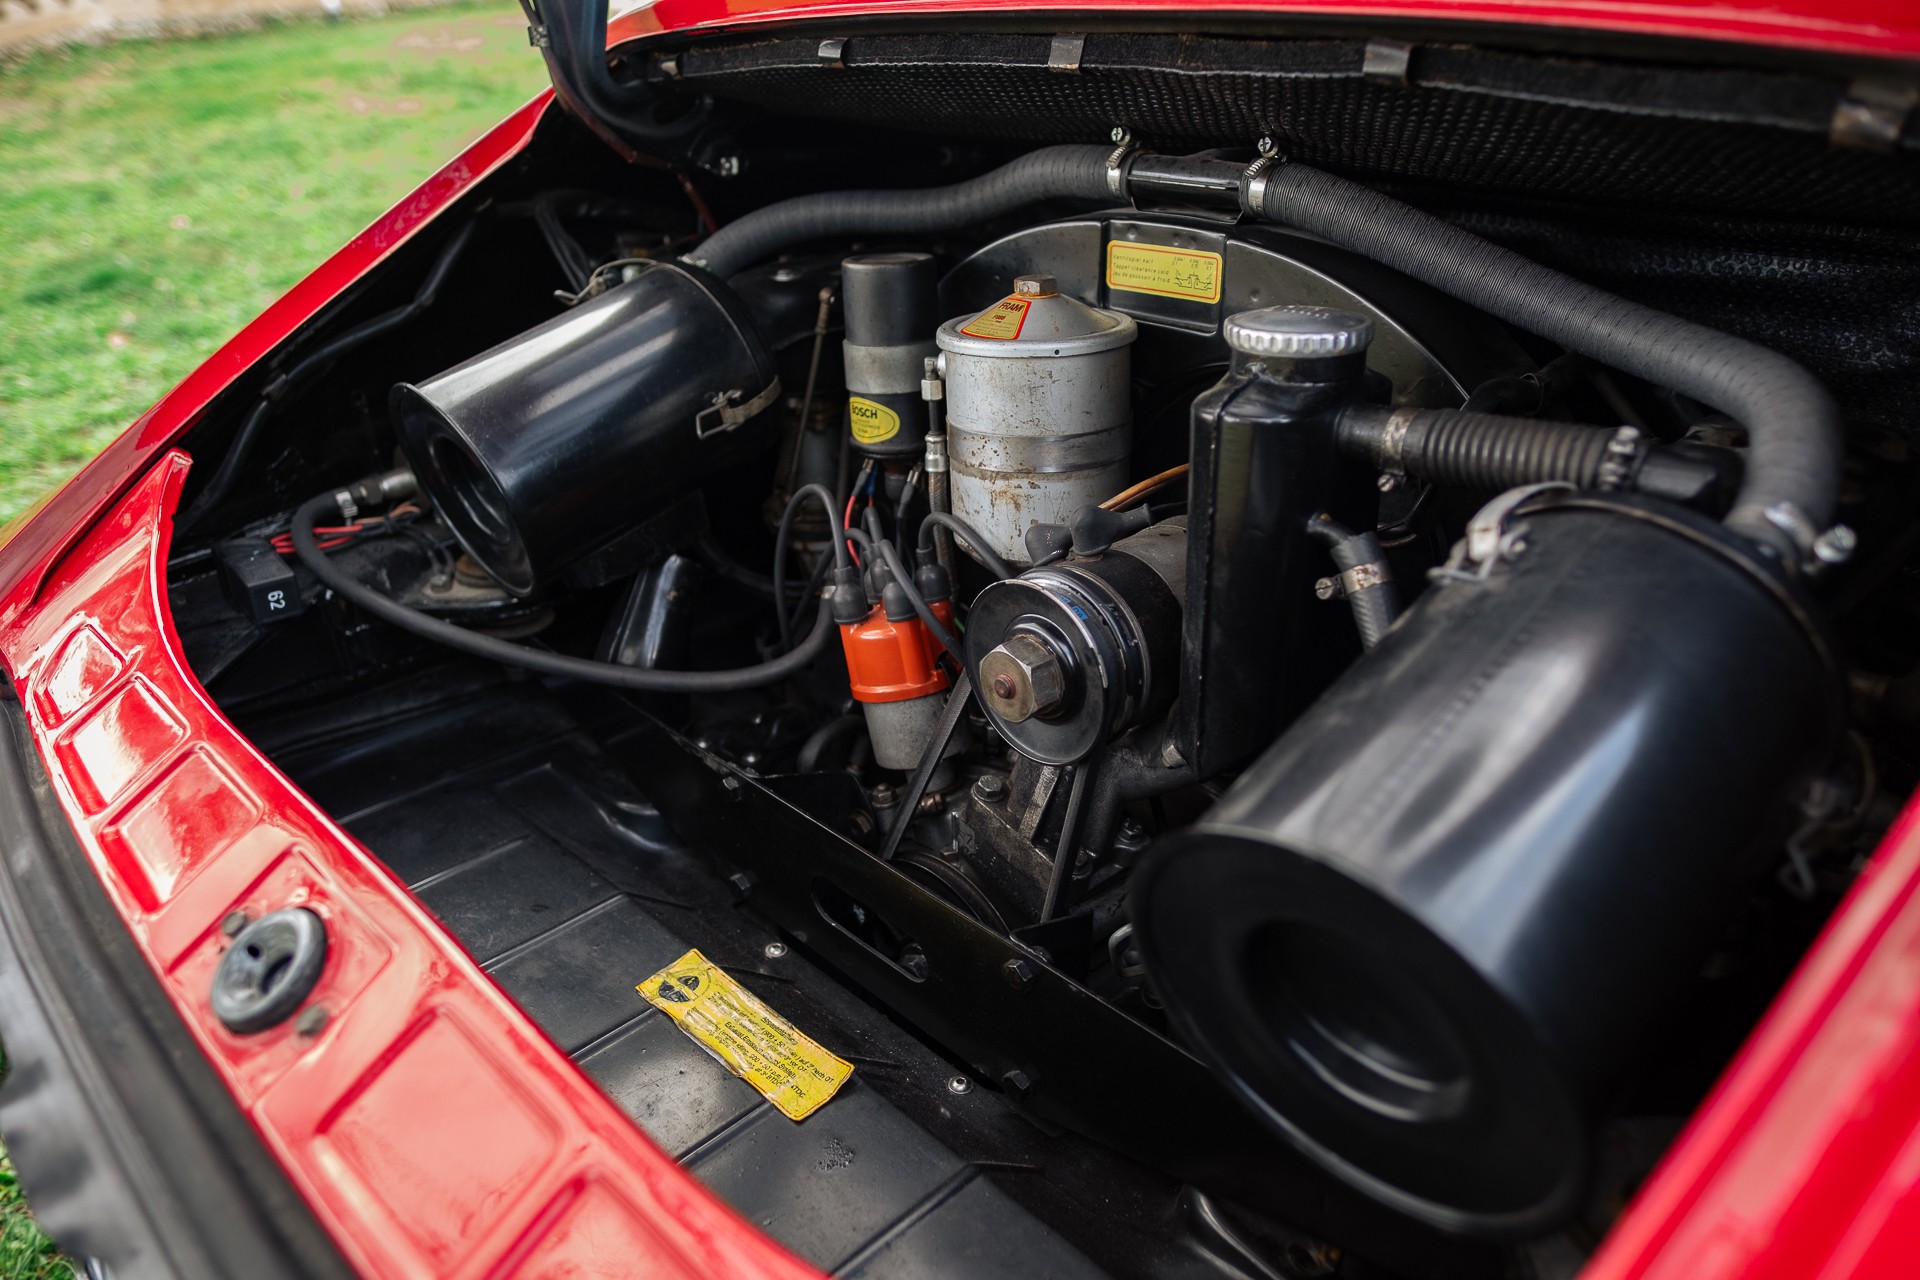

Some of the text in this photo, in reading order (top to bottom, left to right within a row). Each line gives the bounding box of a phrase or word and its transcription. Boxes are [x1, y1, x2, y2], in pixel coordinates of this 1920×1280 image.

[1113, 262, 1130, 270] Tappet
[998, 302, 1025, 312] FRAM
[268, 590, 286, 611] 62
[812, 1067, 827, 1079] nach
